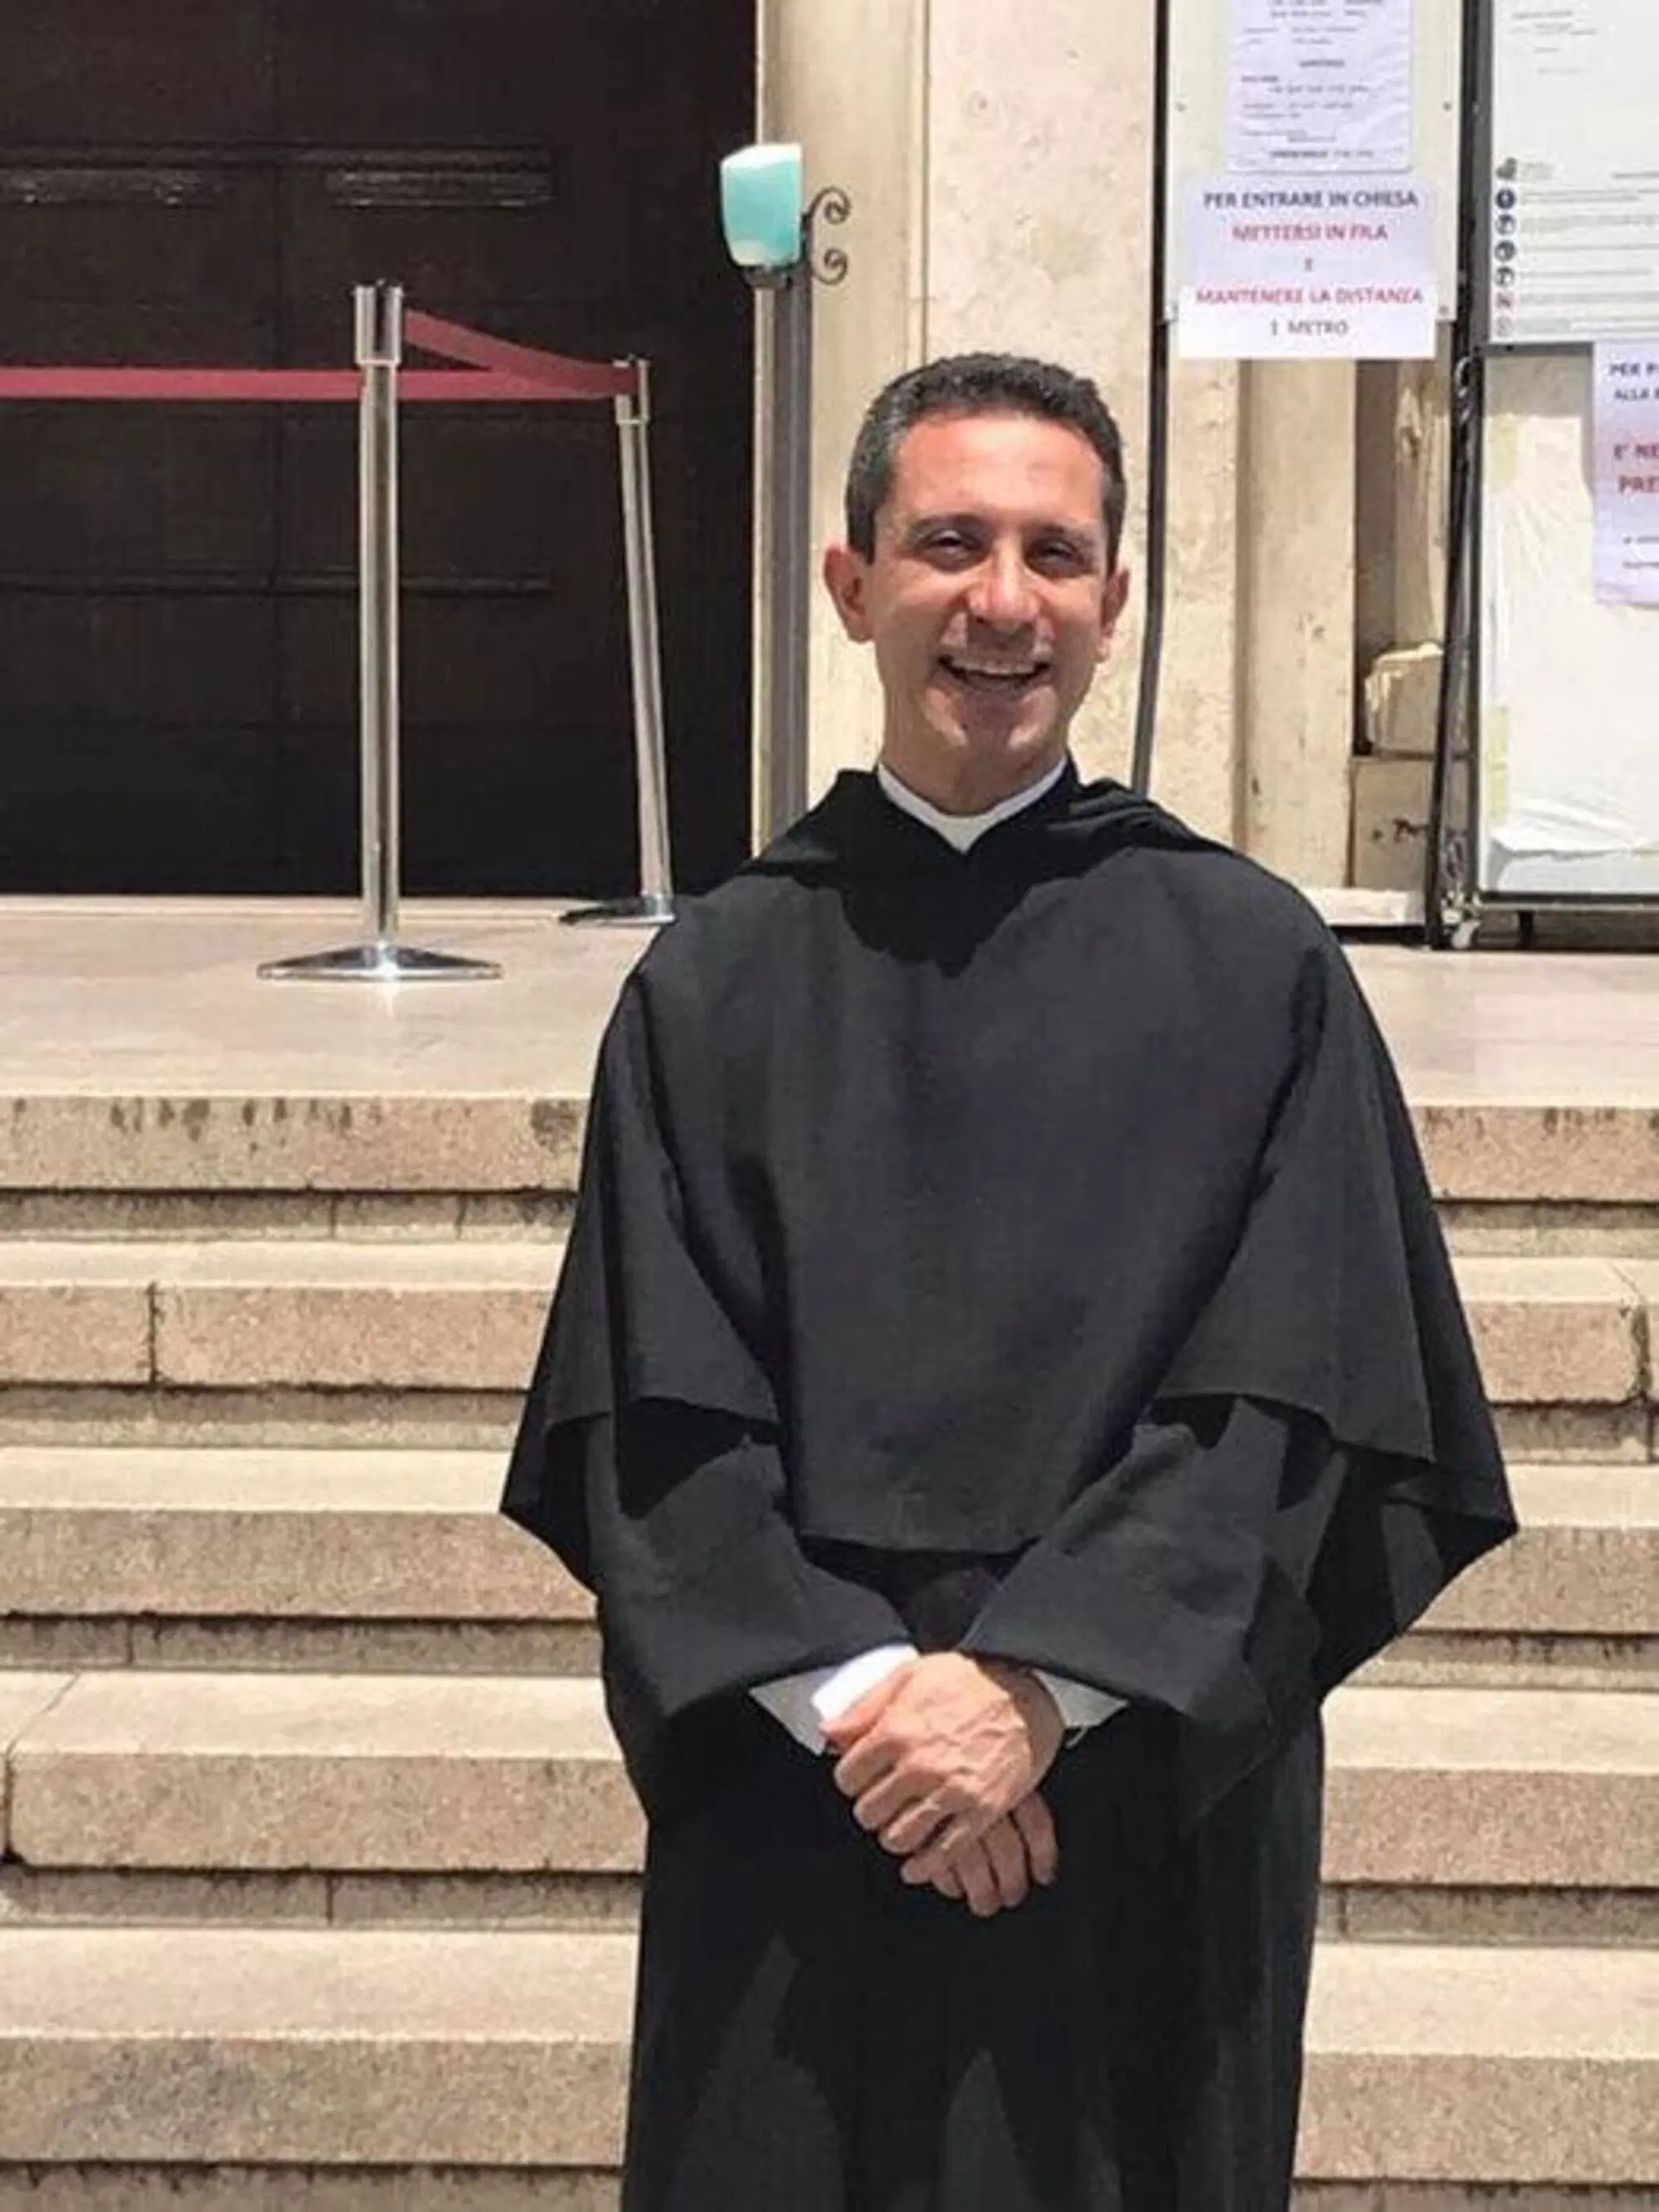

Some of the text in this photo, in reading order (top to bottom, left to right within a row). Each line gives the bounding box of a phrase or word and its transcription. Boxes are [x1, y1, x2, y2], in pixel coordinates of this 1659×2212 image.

[1204, 191, 1418, 207] PER ENTRARE IN CHIESA
[1326, 223, 1346, 239] IN
[1335, 287, 1423, 304] DISTANZA
